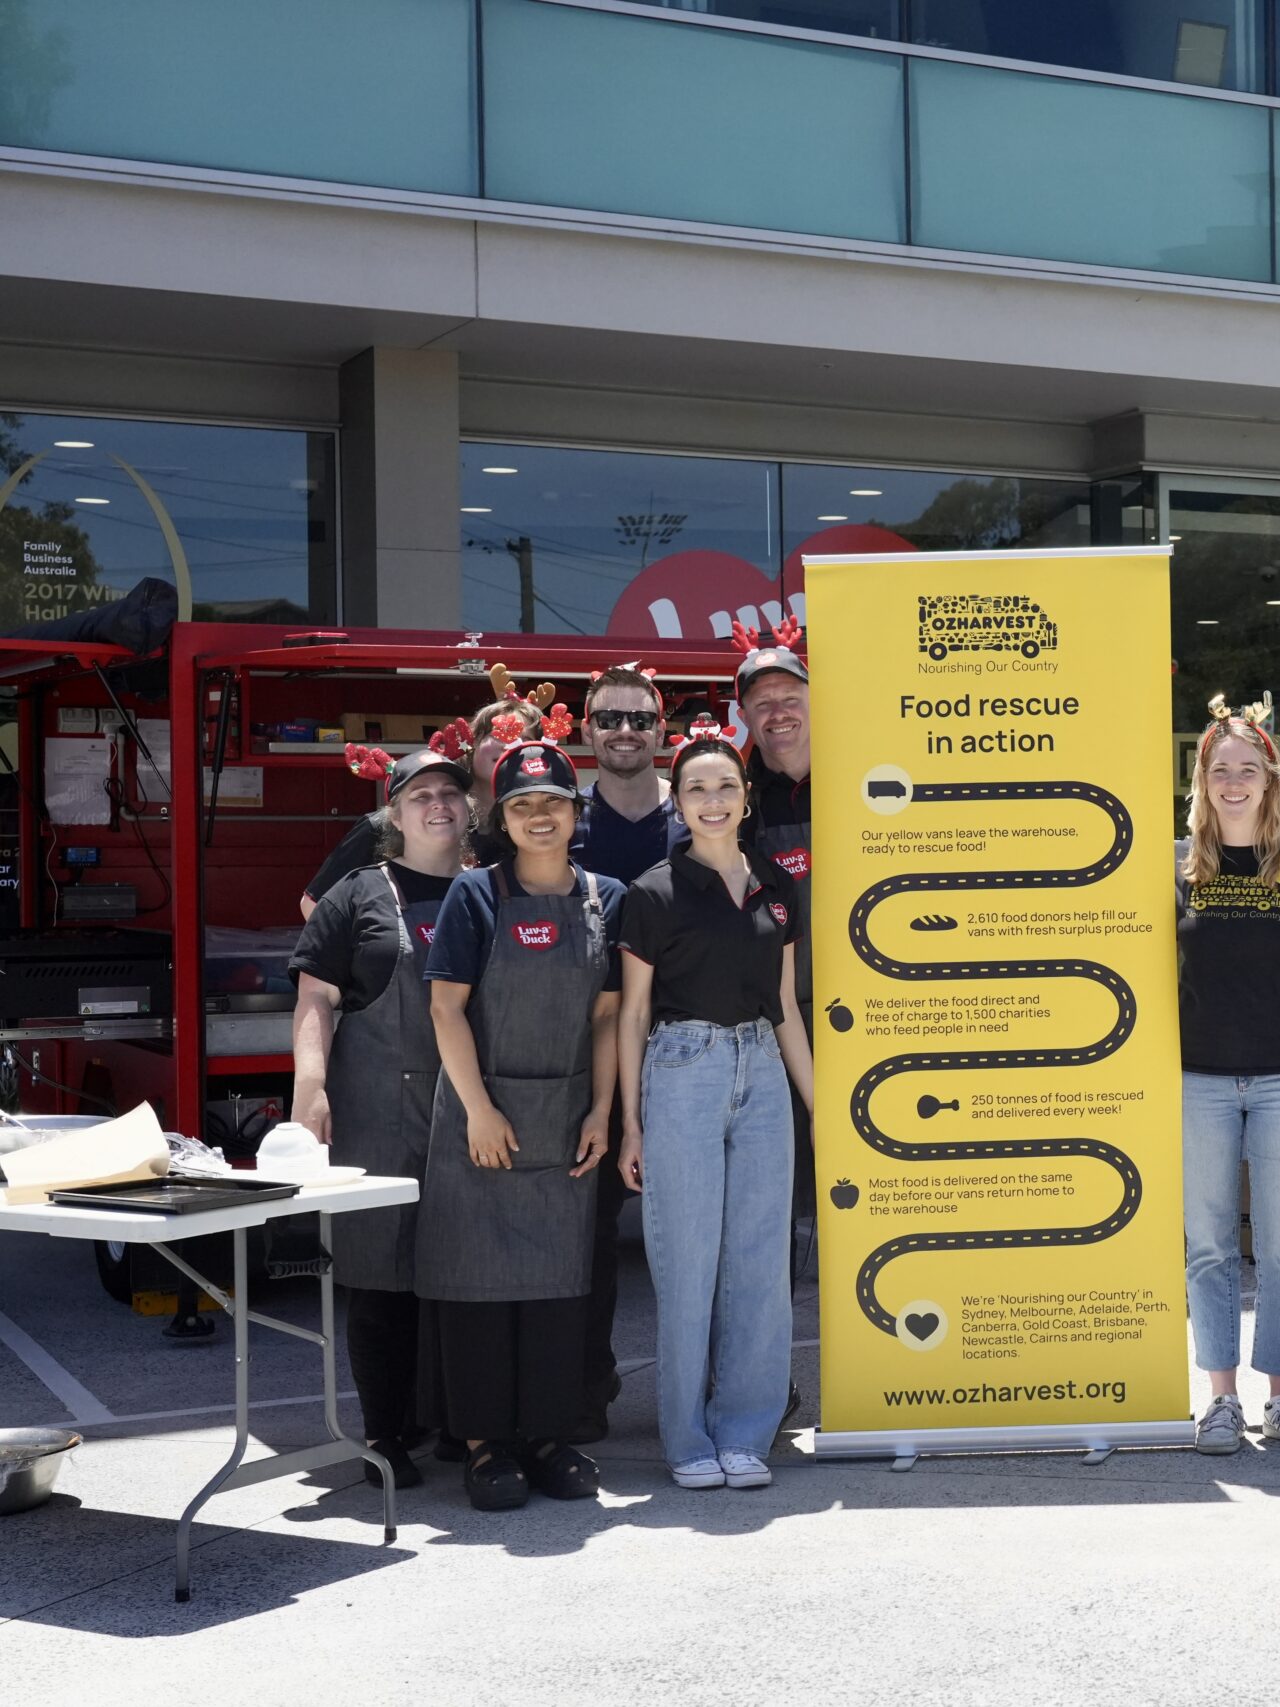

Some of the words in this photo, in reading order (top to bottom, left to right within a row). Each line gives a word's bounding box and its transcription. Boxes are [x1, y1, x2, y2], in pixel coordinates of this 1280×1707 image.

[23, 541, 62, 553] Family
[23, 553, 73, 564] Business
[23, 566, 77, 576] Australia
[25, 583, 78, 599] 2017
[83, 585, 129, 601] Win
[25, 605, 68, 621] Hall
[932, 616, 1036, 631] OZHARVEST
[918, 659, 982, 676] Nourishing
[985, 660, 1009, 673] Our
[1011, 659, 1059, 674] Country
[900, 693, 971, 719] Food
[979, 694, 1080, 718] rescue
[927, 730, 953, 756] in
[960, 728, 1054, 754] action
[861, 830, 884, 841] Our
[885, 829, 924, 843] yellow
[925, 830, 954, 840] vans
[955, 828, 987, 840] leave
[988, 827, 1009, 838] the
[1011, 827, 1079, 837] warehouse,
[862, 842, 896, 856] ready
[897, 843, 911, 854] to
[912, 843, 954, 853] rescue
[956, 841, 986, 852] food!
[784, 863, 808, 874] uck
[1200, 886, 1271, 896] OZHARVEST
[967, 912, 999, 924] 2,610
[1000, 912, 1028, 923] food
[1030, 912, 1072, 922] donors
[1073, 910, 1100, 923] help
[1101, 909, 1115, 920] fill
[1117, 911, 1138, 920] our
[1186, 911, 1229, 920] Nourishing
[967, 928, 995, 937] vans
[997, 925, 1023, 936] with
[1025, 925, 1056, 936] fresh
[1058, 924, 1102, 937] surplus
[1104, 923, 1153, 936] produce
[520, 933, 552, 945] Duck
[864, 998, 884, 1009] We
[886, 998, 927, 1009] deliver
[928, 997, 949, 1008] the
[951, 996, 979, 1007] food
[980, 995, 1016, 1006] direct
[1017, 994, 1040, 1005] and
[864, 1011, 890, 1023] free
[891, 1010, 905, 1022] of
[906, 1011, 948, 1024] charge
[950, 1010, 963, 1021] to
[965, 1008, 997, 1021] 1,500
[998, 1007, 1051, 1019] charities
[865, 1025, 891, 1036] who
[893, 1024, 920, 1035] feed
[922, 1024, 964, 1037] people
[965, 1023, 977, 1033] in
[979, 1022, 1009, 1033] need
[971, 1094, 994, 1106] 250
[995, 1095, 1038, 1105] tonnes
[1040, 1092, 1053, 1104] of
[1054, 1092, 1082, 1103] food
[1084, 1091, 1094, 1102] is
[1096, 1090, 1144, 1102] rescued
[971, 1108, 994, 1119] and
[996, 1106, 1051, 1118] delivered
[1052, 1107, 1086, 1118] every
[1087, 1104, 1122, 1115] week!
[868, 1178, 900, 1189] Most
[901, 1176, 929, 1188] food
[931, 1176, 942, 1187] is
[943, 1174, 998, 1186] delivered
[1000, 1175, 1016, 1185] on
[1018, 1173, 1039, 1184] the
[1040, 1173, 1073, 1183] same
[868, 1192, 891, 1204] day
[892, 1190, 932, 1202] before
[934, 1191, 955, 1200] our
[956, 1190, 985, 1199] vans
[986, 1188, 1024, 1198] return
[1026, 1186, 1060, 1197] home
[1062, 1185, 1075, 1196] to
[869, 1204, 890, 1216] the
[892, 1204, 958, 1215] warehouse
[1066, 1293, 1087, 1303] our
[1142, 1289, 1153, 1299] in
[961, 1309, 1007, 1321] Sydney,
[1010, 1304, 1076, 1318] Melbourne,
[1078, 1303, 1133, 1315] Adelaide,
[1135, 1301, 1170, 1313] Perth,
[961, 1321, 1020, 1333] Canberra,
[1022, 1319, 1050, 1331] Gold
[1052, 1318, 1091, 1330] Coast,
[1093, 1317, 1148, 1329] Brisbane,
[962, 1334, 1027, 1346] Newcastle,
[1029, 1333, 1068, 1344] Cairns
[1070, 1331, 1093, 1342] and
[1094, 1329, 1142, 1344] regional
[962, 1349, 1020, 1360] locations.
[883, 1380, 1126, 1408] www.ozharvest.org
